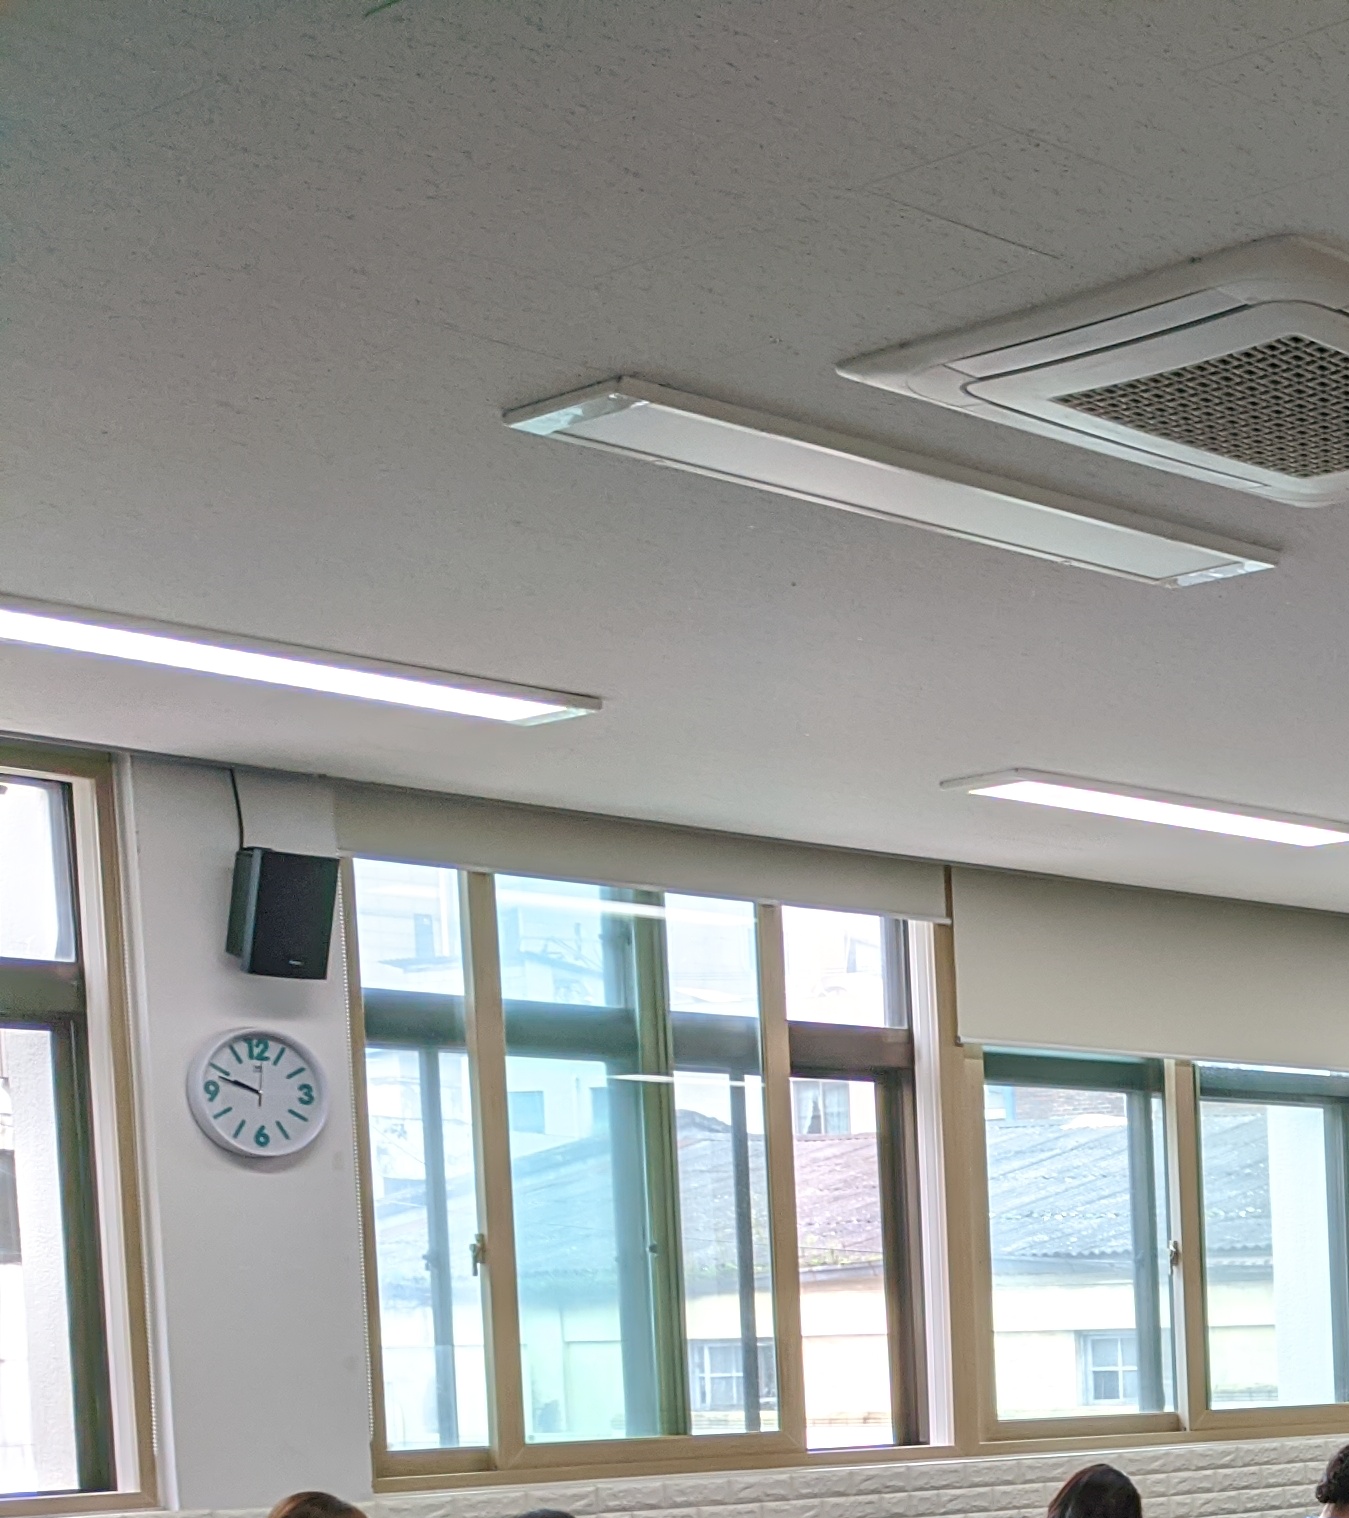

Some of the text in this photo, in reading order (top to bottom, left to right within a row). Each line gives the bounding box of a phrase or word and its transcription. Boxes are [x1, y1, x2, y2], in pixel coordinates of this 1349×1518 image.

[243, 1038, 270, 1061] 12
[203, 1079, 220, 1102] 9
[297, 1083, 315, 1105] 3
[254, 1125, 270, 1147] 6
